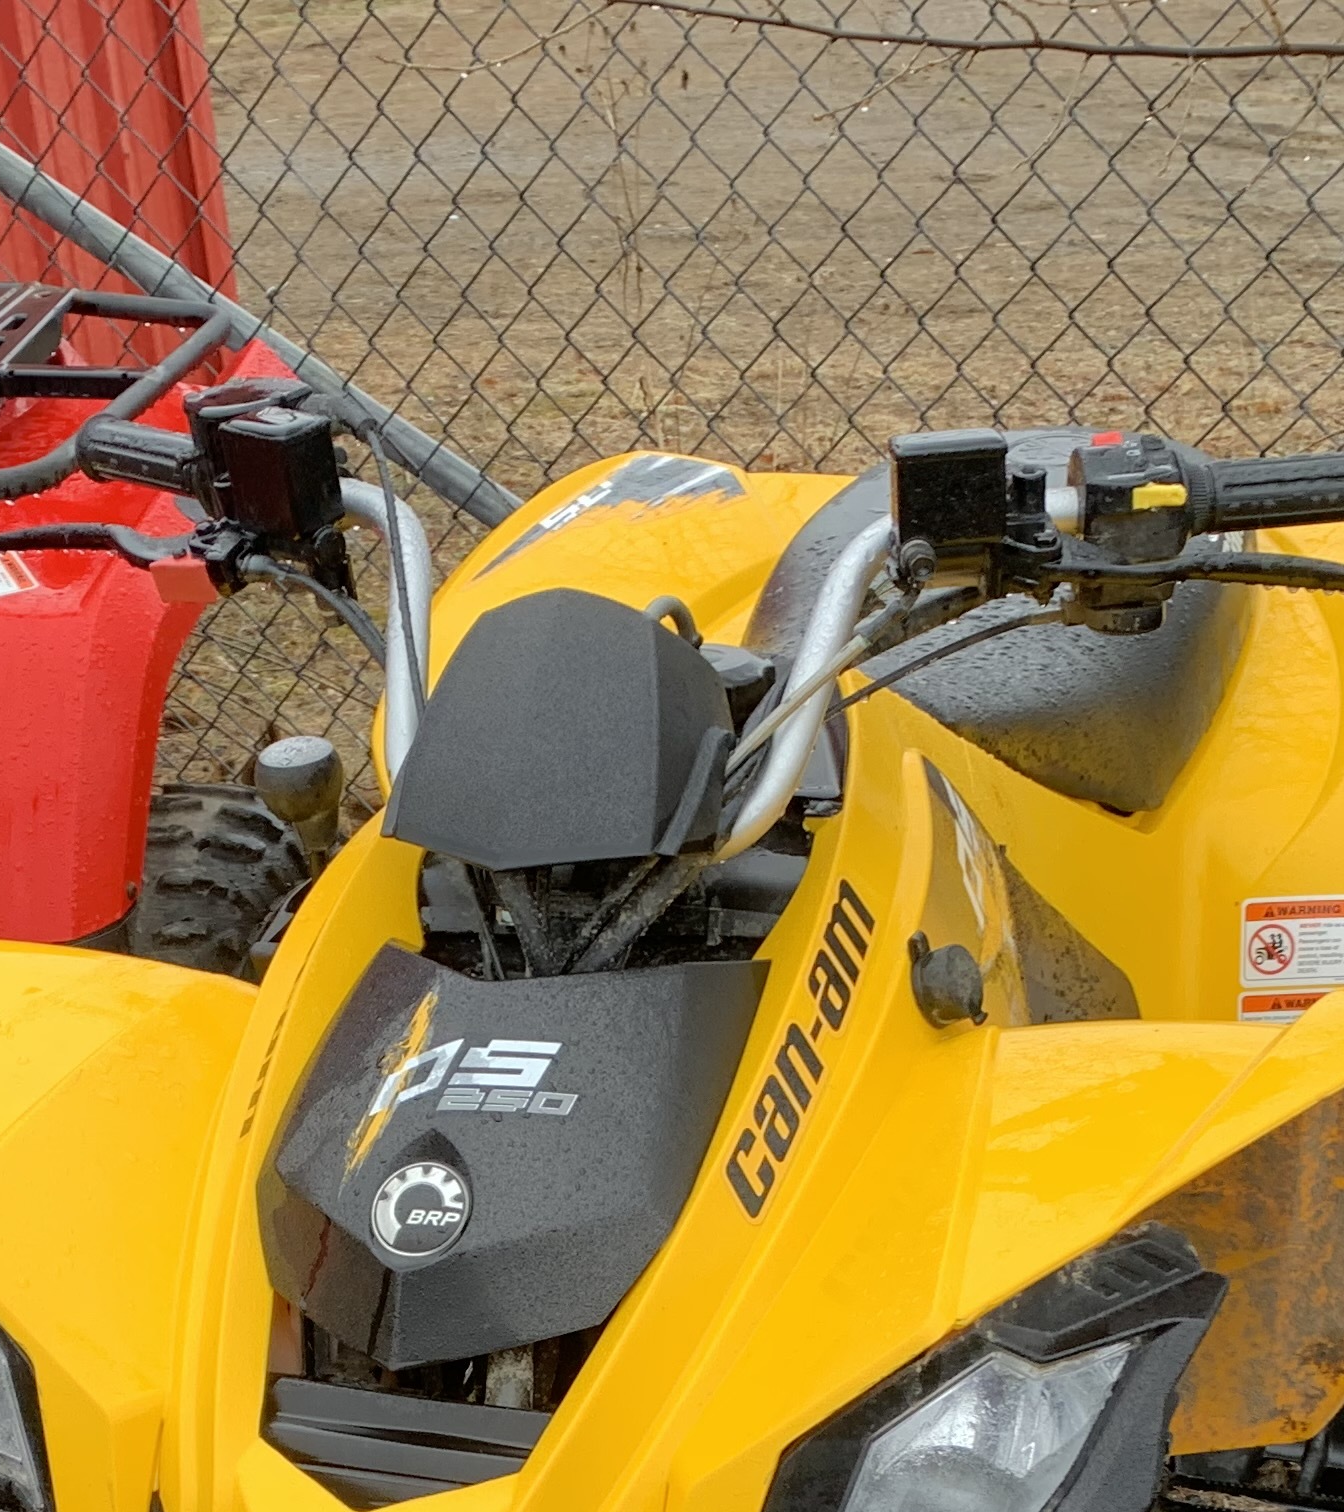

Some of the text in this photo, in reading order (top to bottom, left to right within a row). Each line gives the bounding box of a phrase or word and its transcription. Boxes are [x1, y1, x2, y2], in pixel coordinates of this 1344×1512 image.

[1277, 904, 1342, 916] WARNING
[436, 1087, 580, 1116] 250
[405, 1208, 461, 1227] BRP
